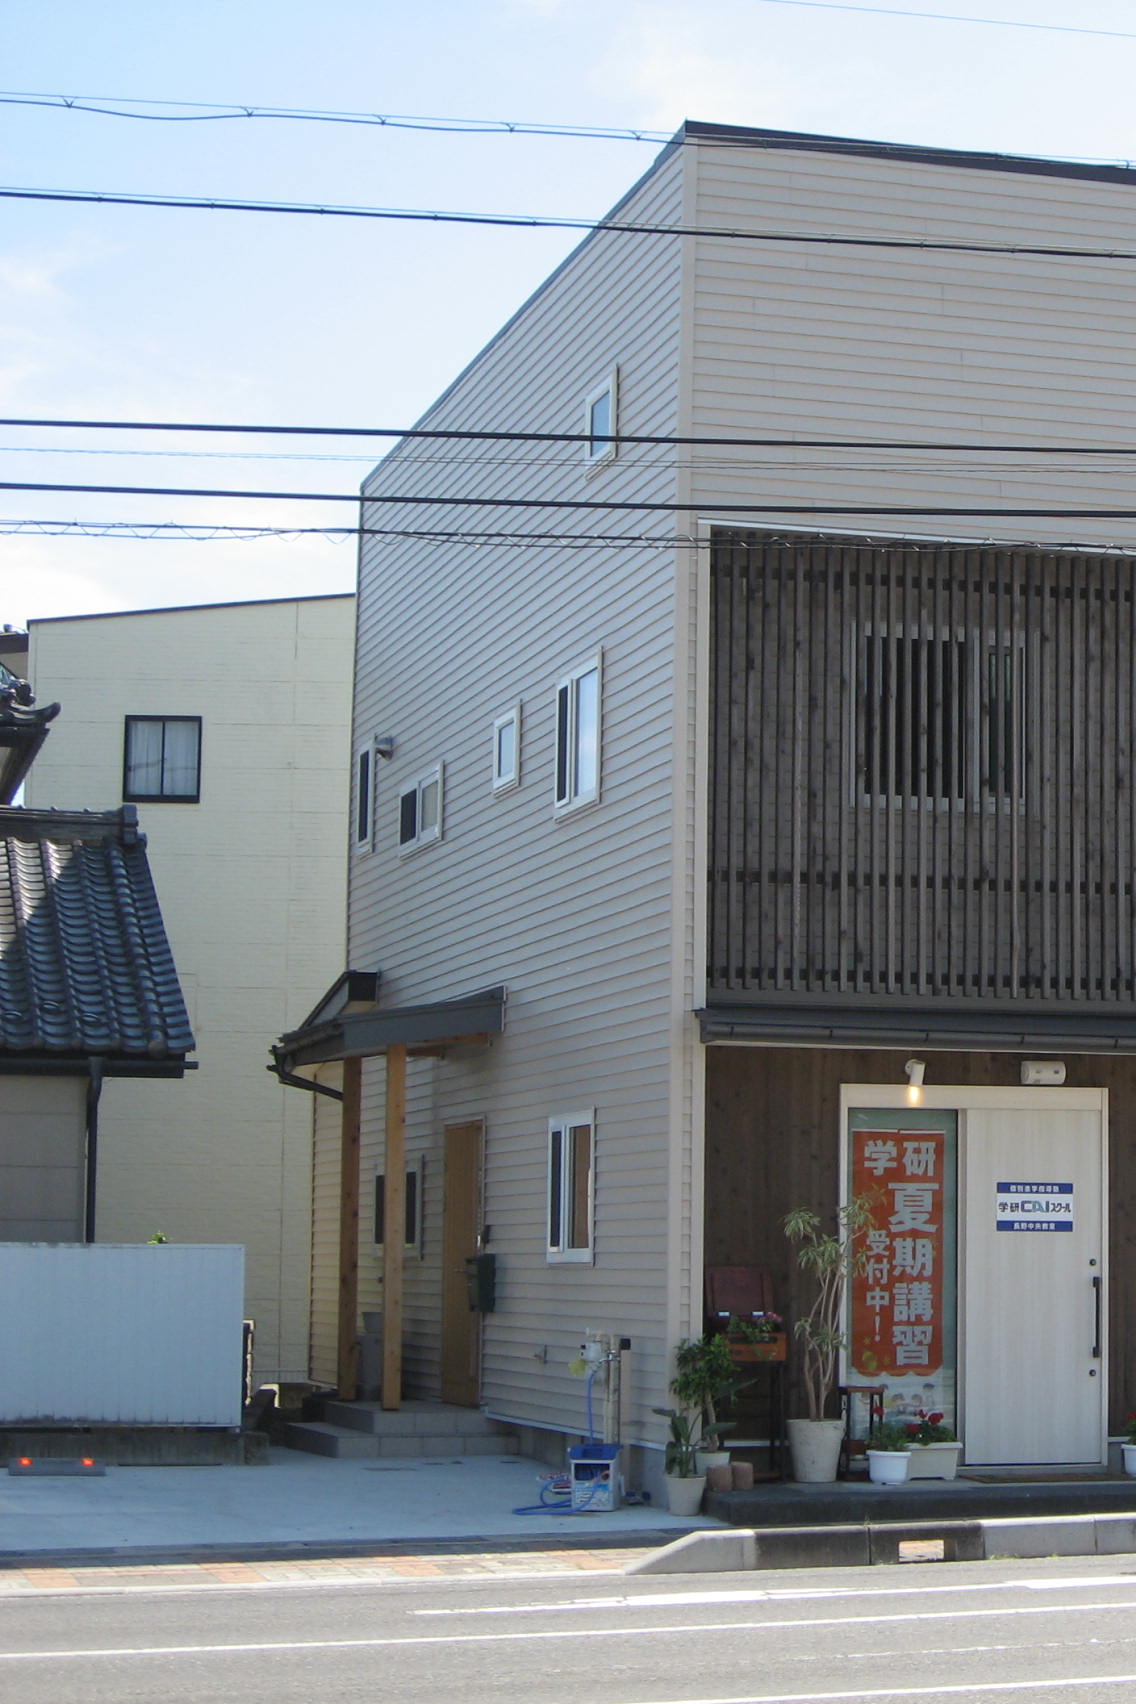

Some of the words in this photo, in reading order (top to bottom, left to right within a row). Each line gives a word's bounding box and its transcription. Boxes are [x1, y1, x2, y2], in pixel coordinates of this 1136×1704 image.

[864, 1139, 936, 1176] 学研
[888, 1182, 939, 1366] 夏期講習
